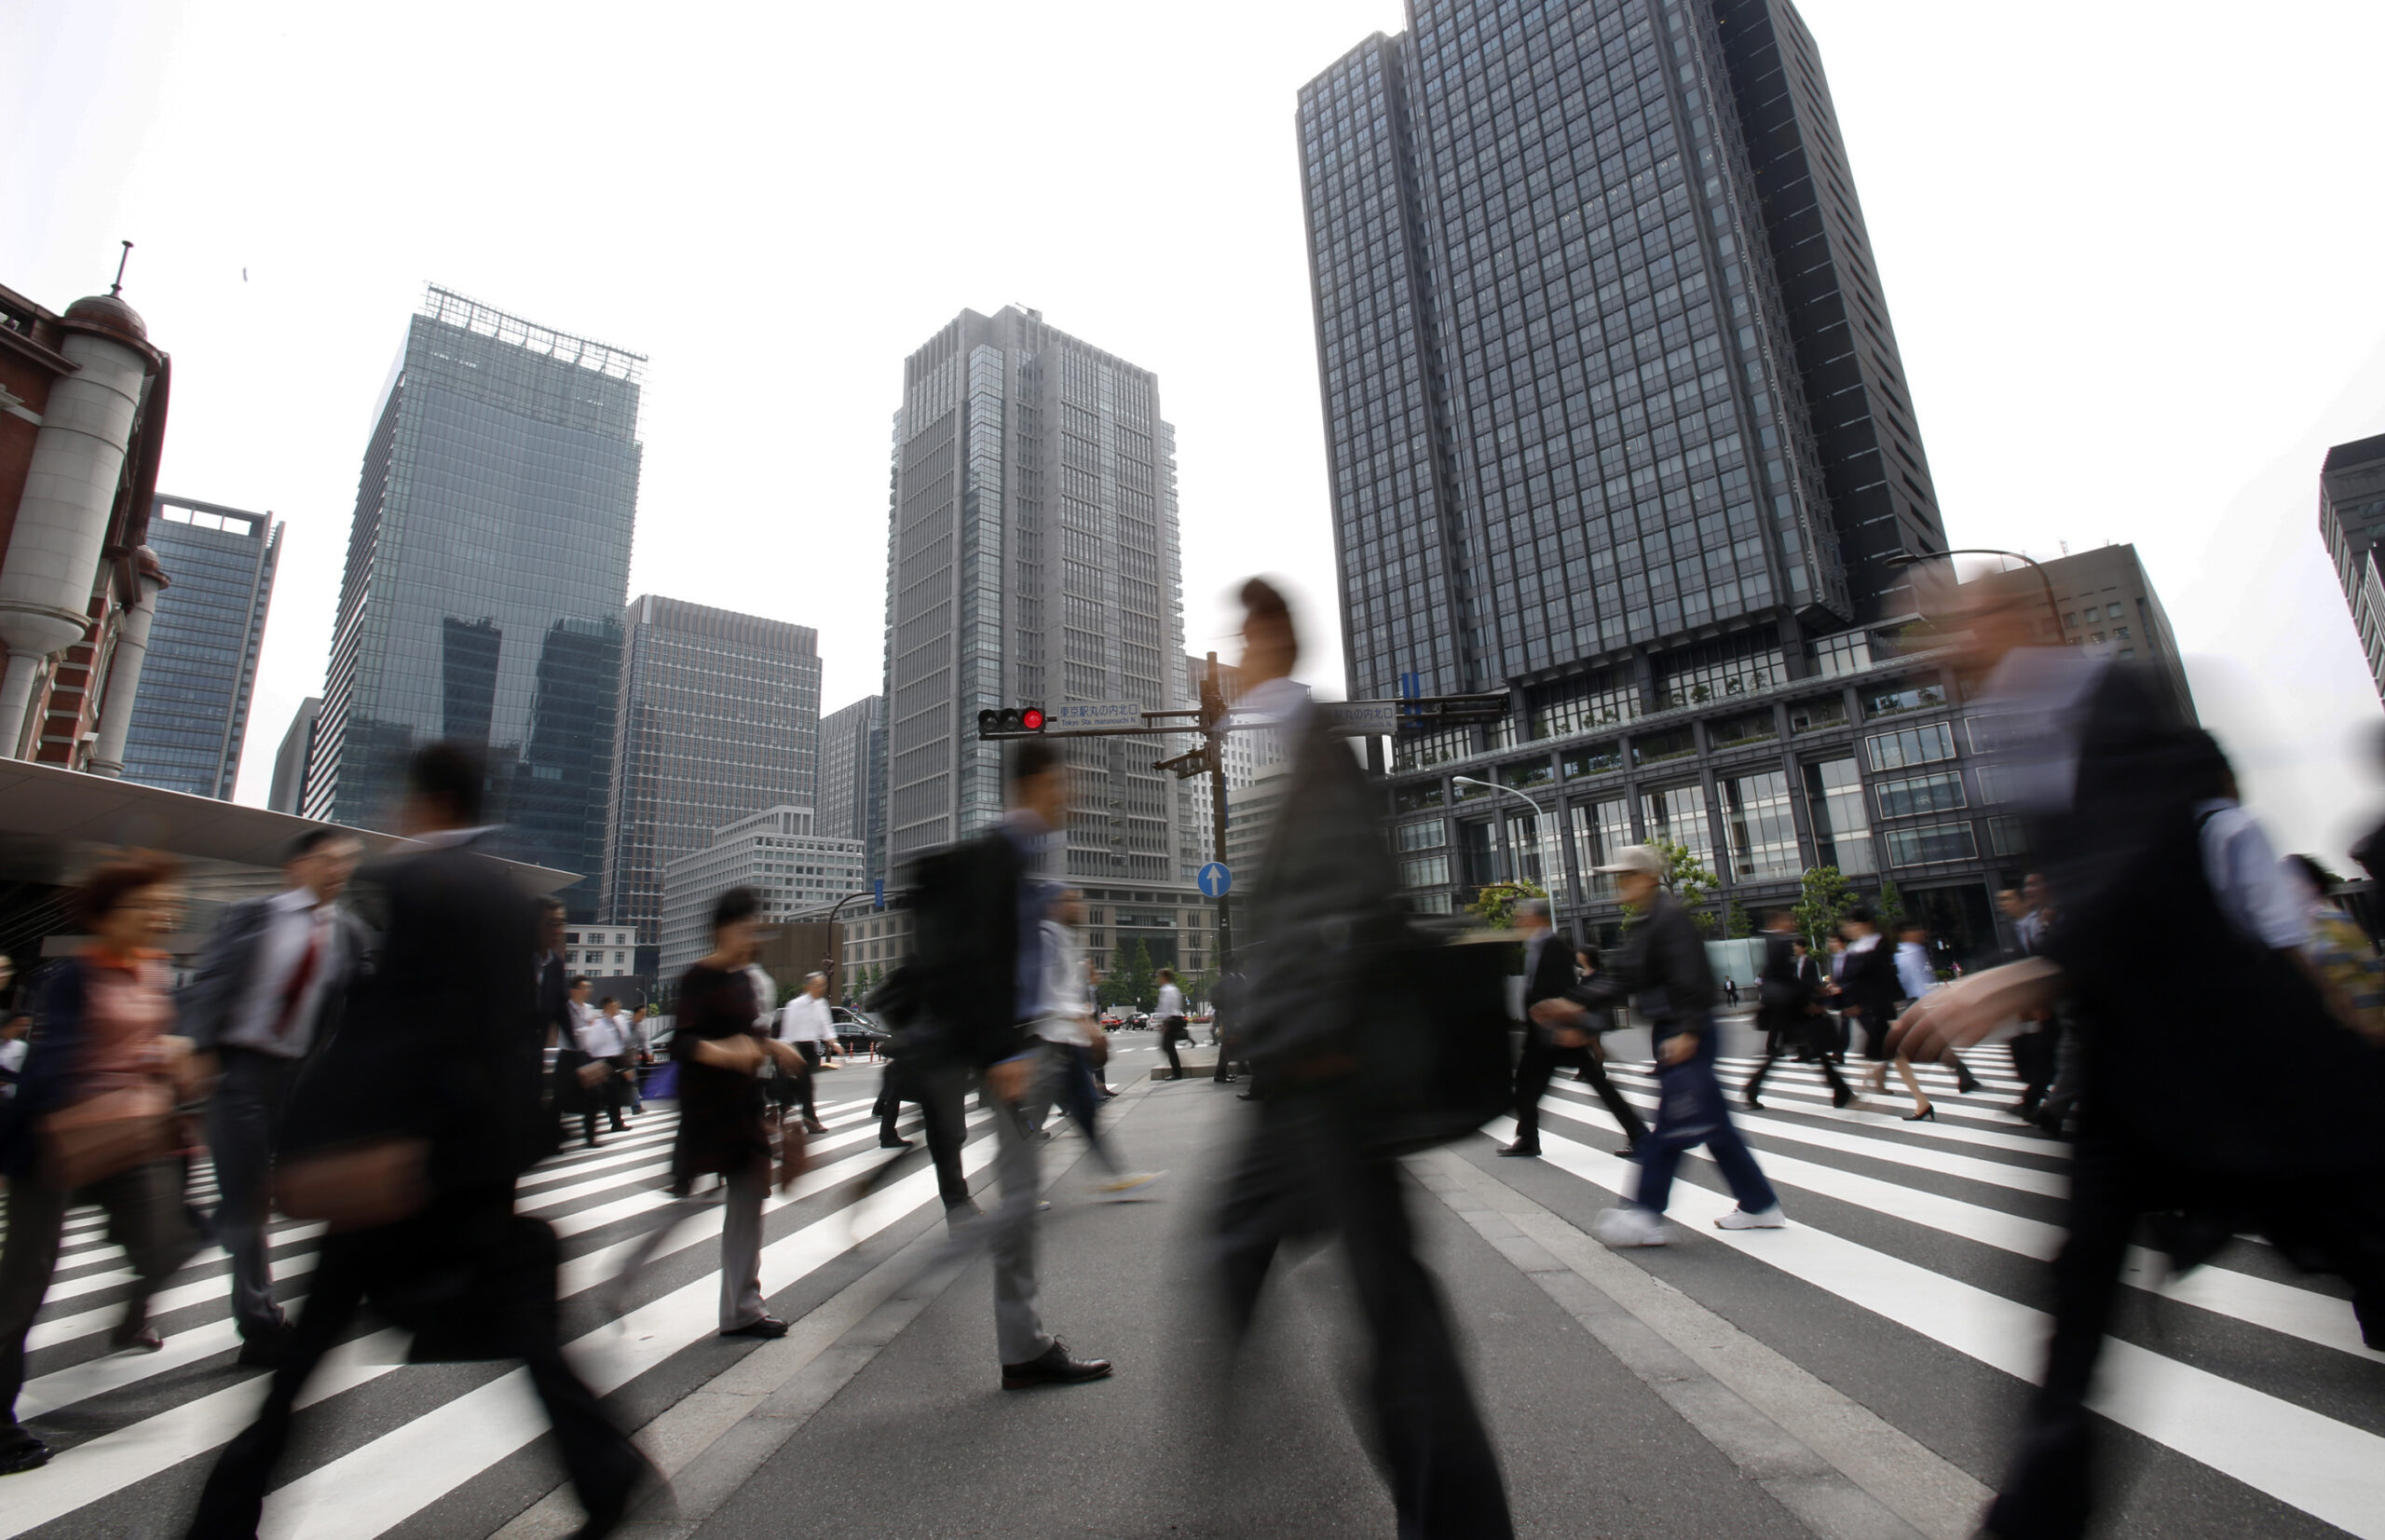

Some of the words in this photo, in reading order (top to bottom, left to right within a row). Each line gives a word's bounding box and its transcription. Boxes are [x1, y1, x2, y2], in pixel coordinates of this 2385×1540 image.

[1060, 704, 1138, 717] 東京駅丸の内北口
